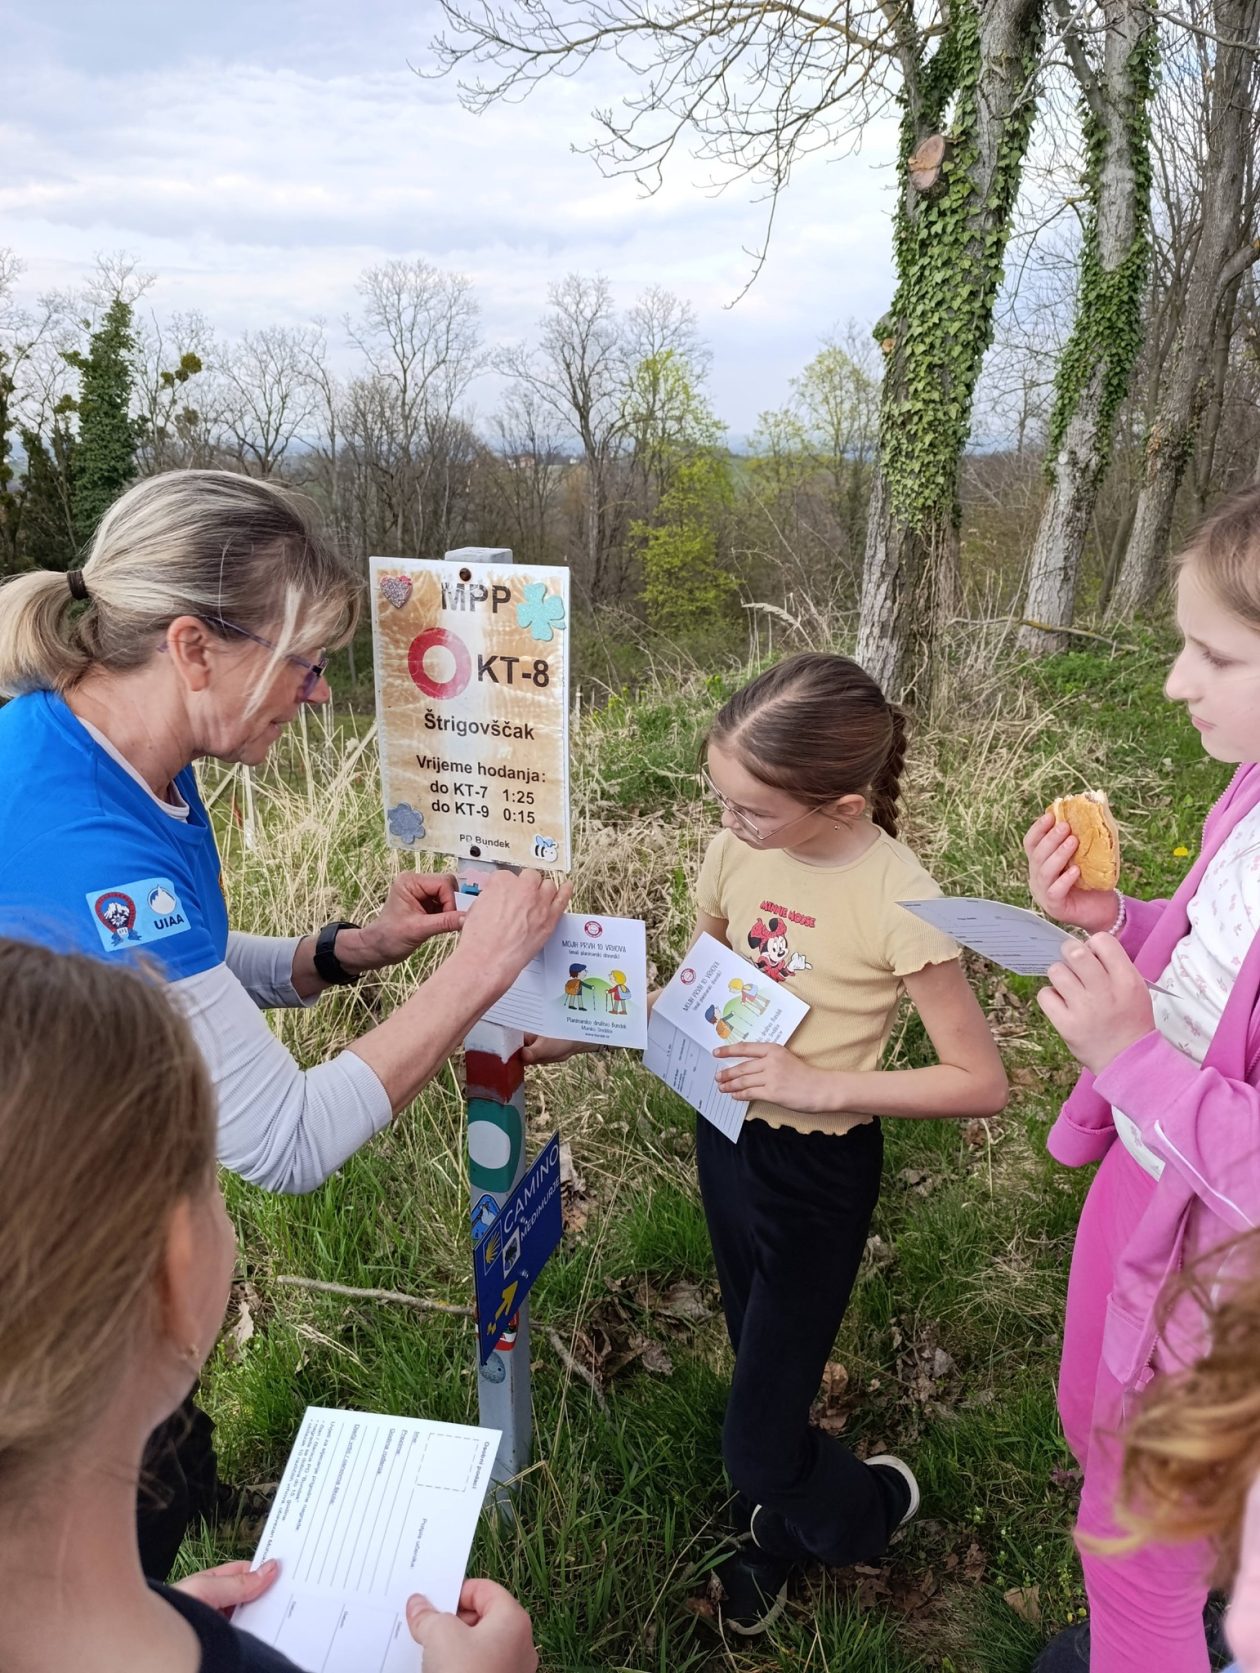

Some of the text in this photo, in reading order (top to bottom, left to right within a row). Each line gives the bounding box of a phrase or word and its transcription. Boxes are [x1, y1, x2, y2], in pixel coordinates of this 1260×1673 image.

[441, 582, 512, 613] MPP
[477, 654, 550, 688] KT-8
[424, 709, 535, 740] Štrigovščak
[416, 755, 546, 784] Vrijeme hodanja:
[430, 780, 535, 805] do KT-7 1:25
[431, 800, 536, 824] do KT-9 0:15
[475, 836, 510, 849] Bundek
[154, 914, 185, 930] UIAA
[504, 1144, 558, 1233] CAMINO
